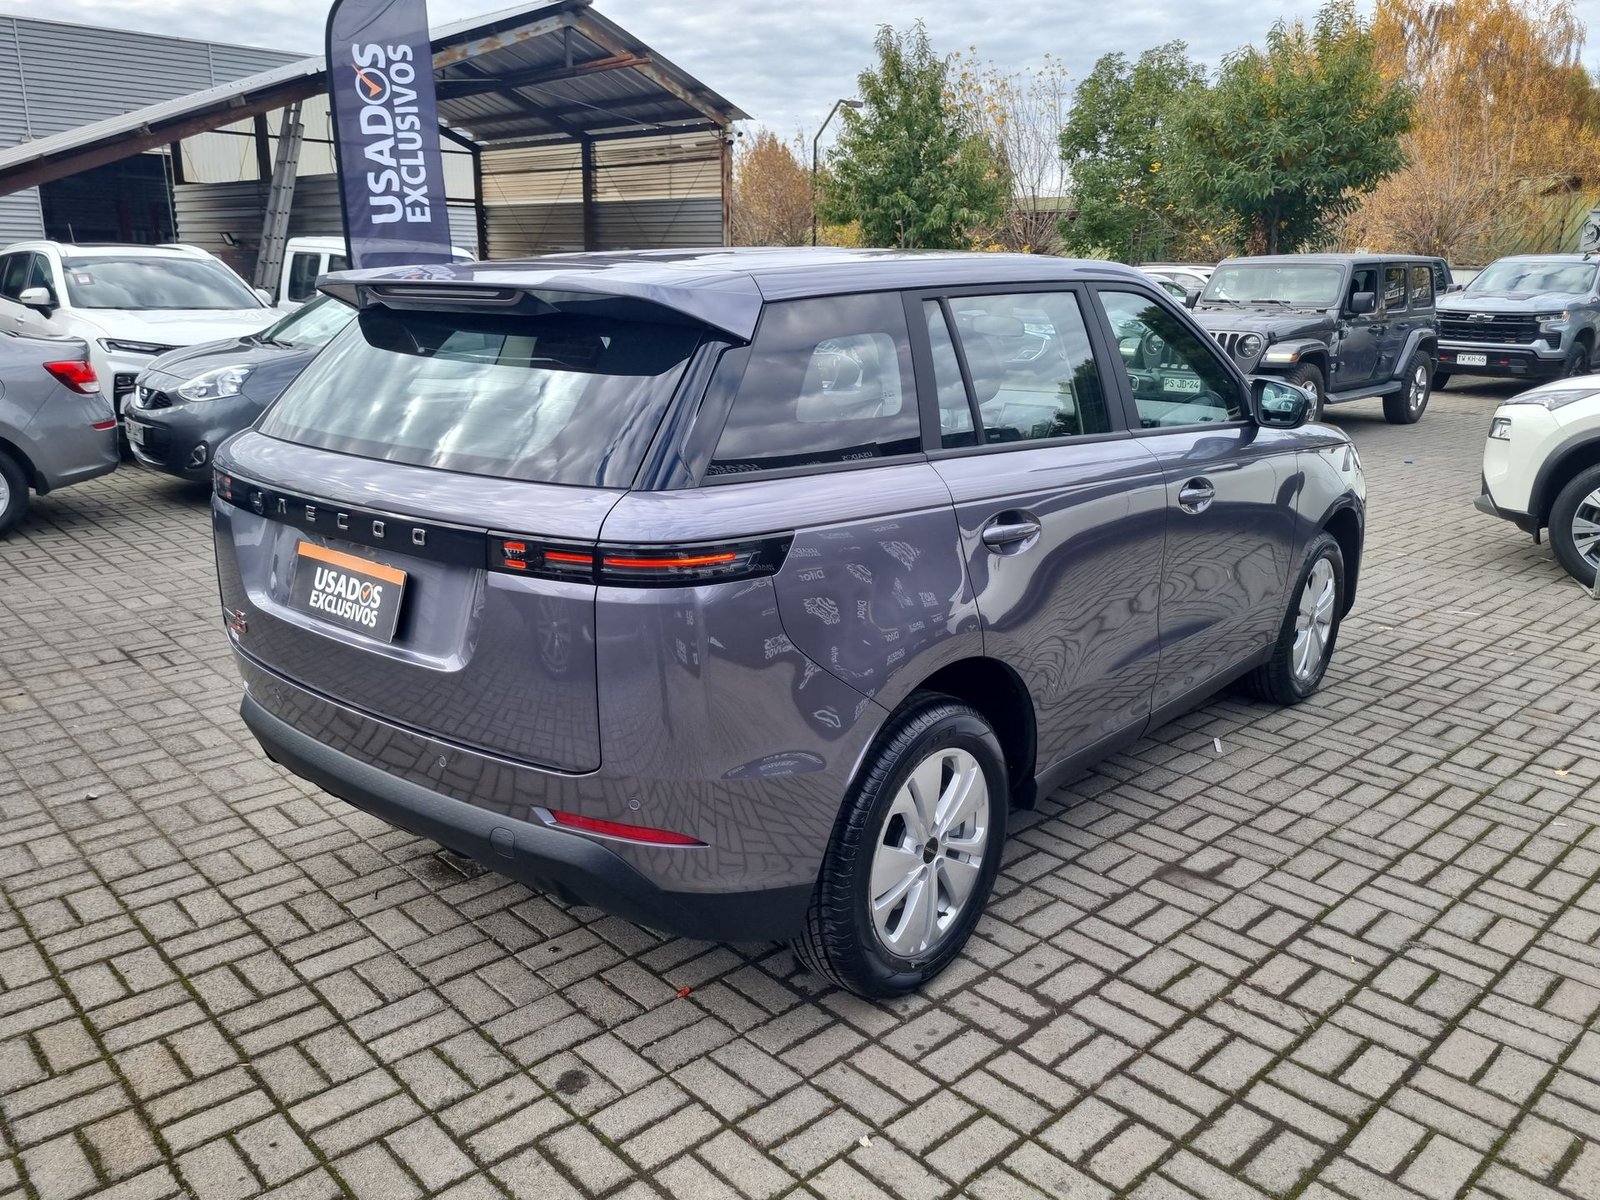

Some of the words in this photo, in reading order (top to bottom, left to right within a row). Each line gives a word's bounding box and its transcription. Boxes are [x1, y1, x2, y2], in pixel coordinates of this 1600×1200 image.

[352, 43, 404, 224] USADOS
[387, 44, 432, 223] EXCLUSIVOS
[309, 589, 378, 628] EXCLUSIVOS
[314, 567, 383, 609] USADOS
